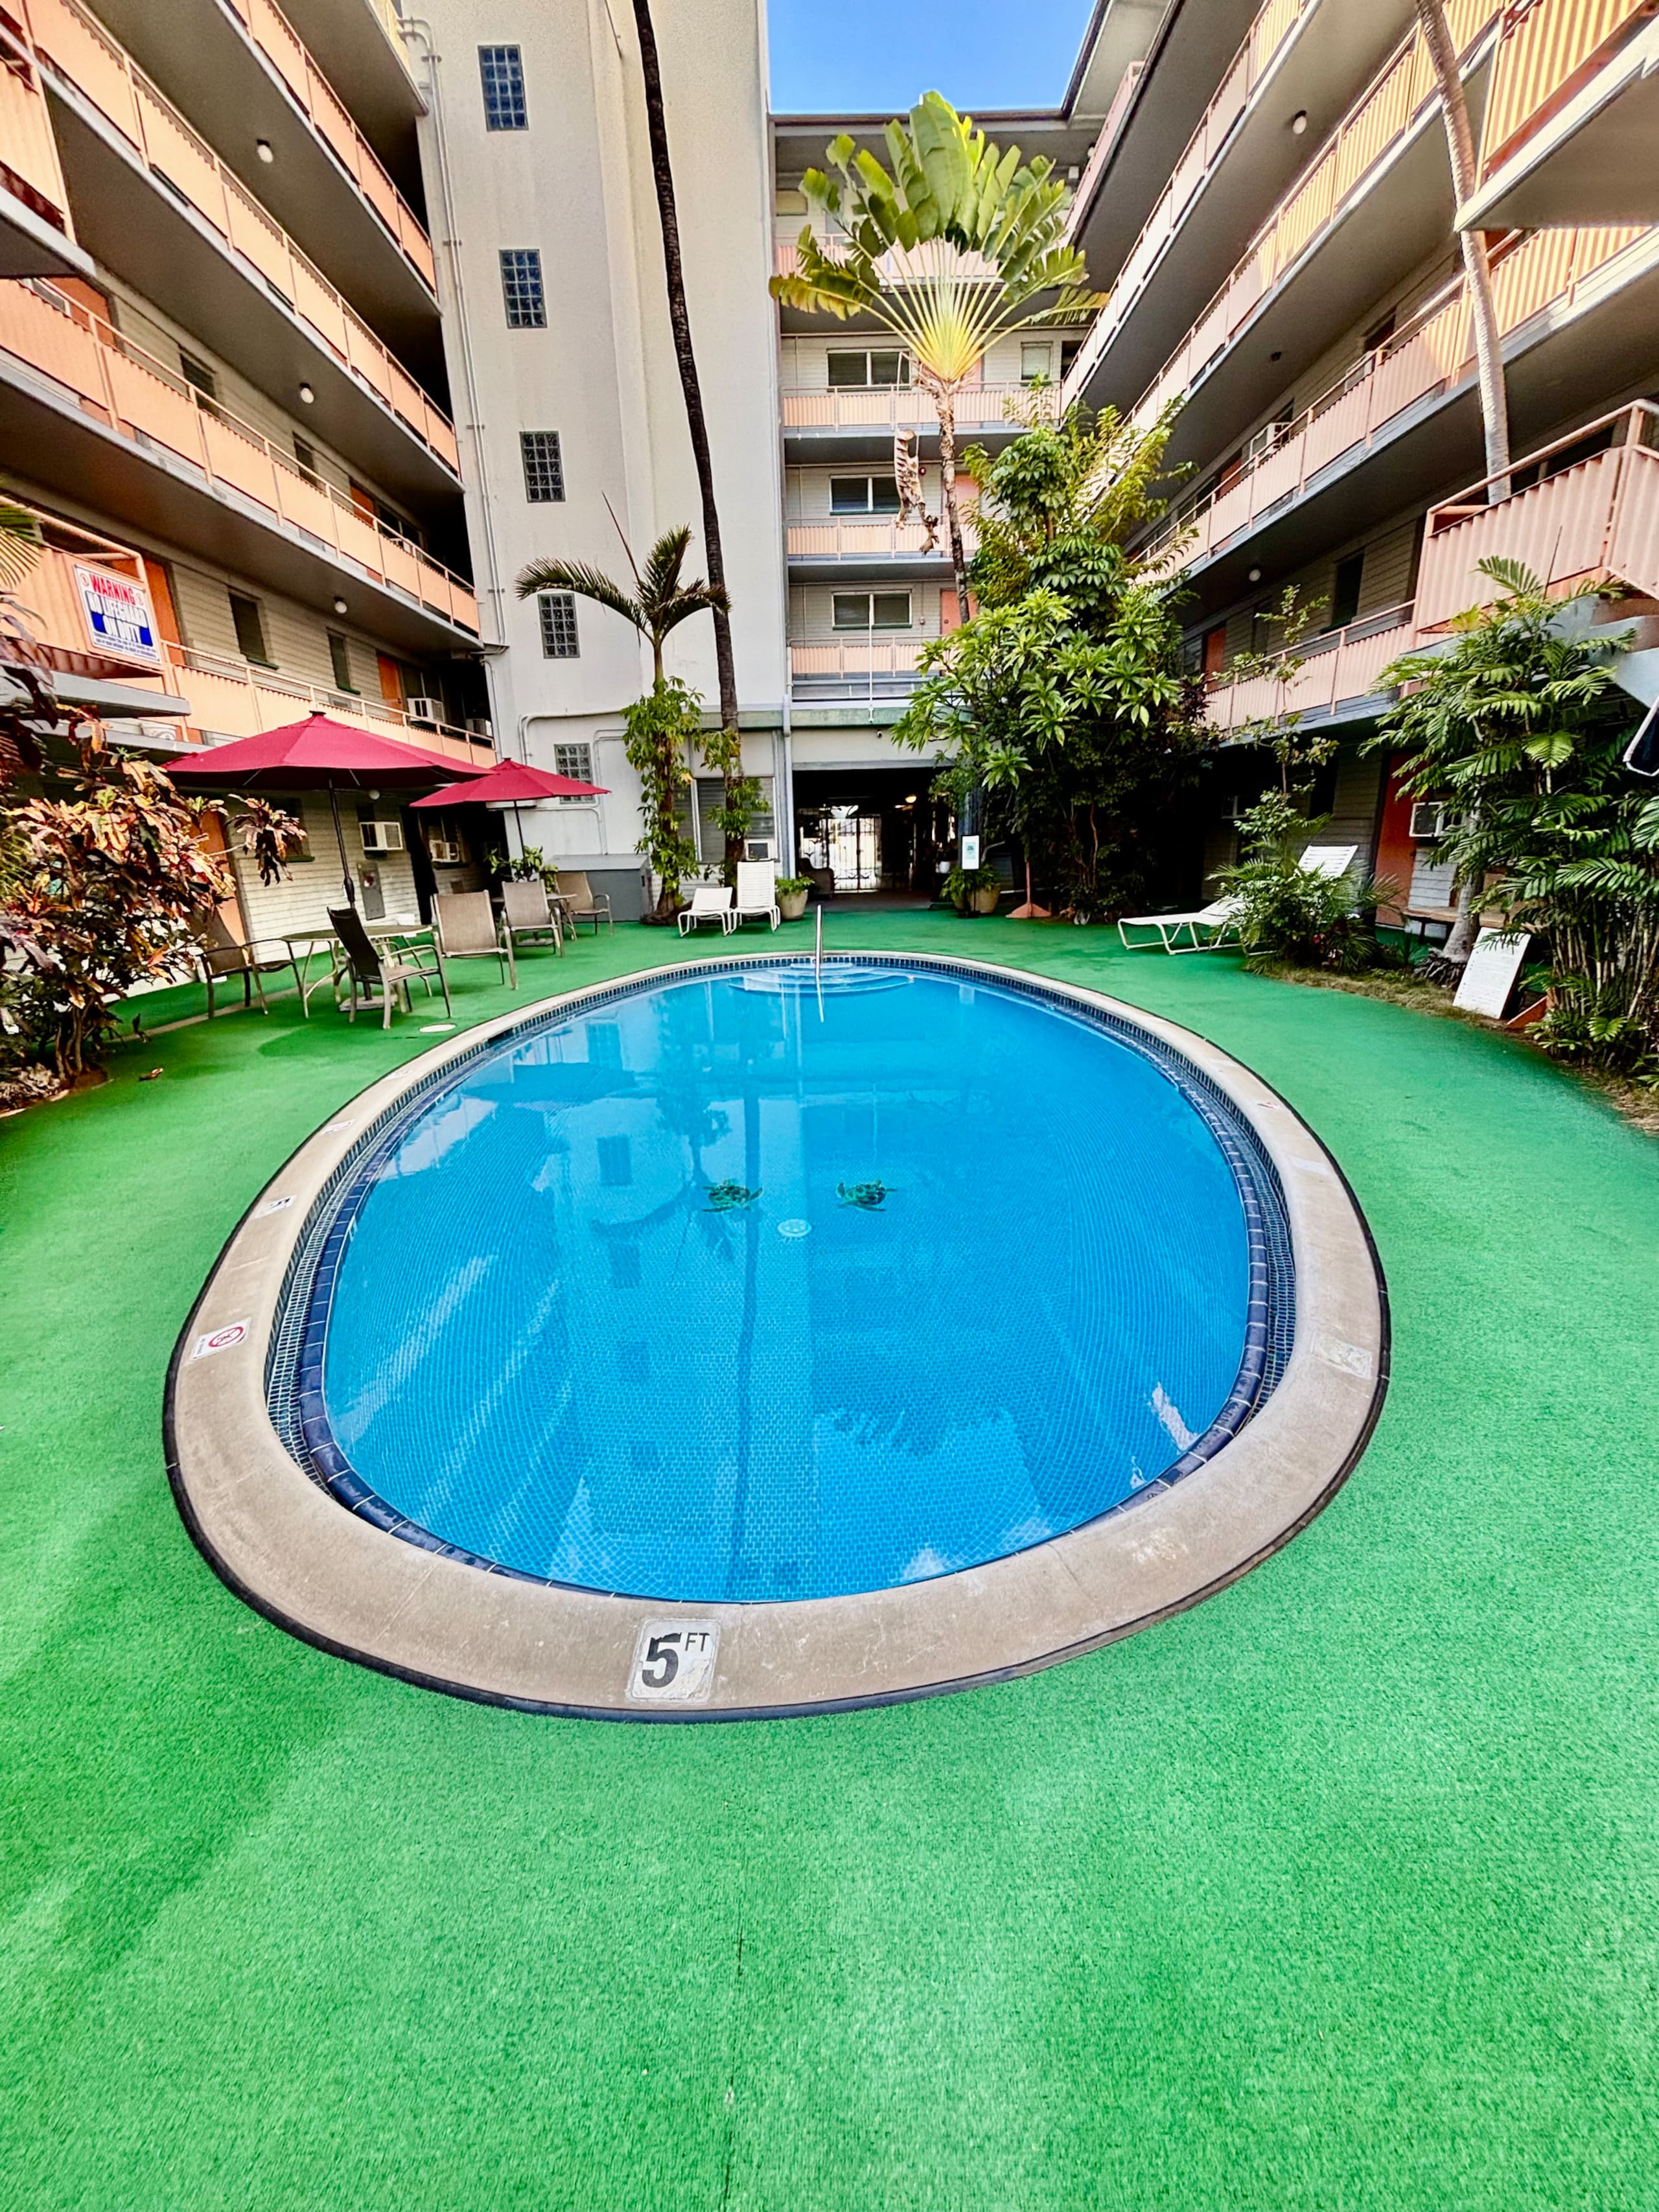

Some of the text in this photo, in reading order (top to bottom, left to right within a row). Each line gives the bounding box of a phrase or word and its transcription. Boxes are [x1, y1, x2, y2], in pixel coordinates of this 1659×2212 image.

[86, 591, 104, 615] NO
[89, 573, 136, 605] WARNING
[102, 614, 119, 637] ON
[115, 619, 142, 644] DUTY
[642, 1632, 710, 1688] 5 FT
